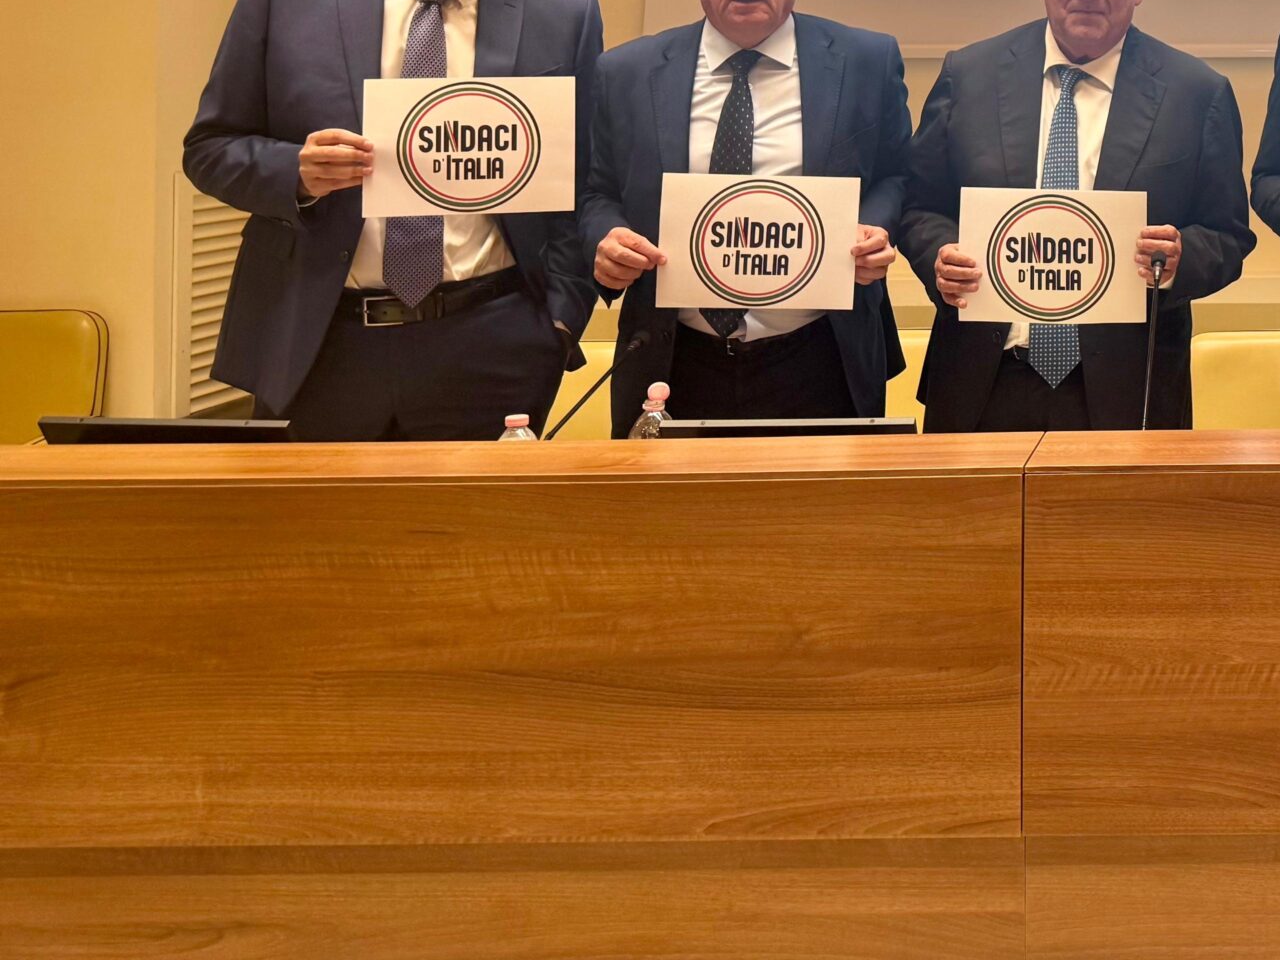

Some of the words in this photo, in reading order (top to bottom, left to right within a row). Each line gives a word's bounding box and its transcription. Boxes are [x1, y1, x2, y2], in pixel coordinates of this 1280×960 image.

[418, 120, 518, 153] SINDACI
[710, 216, 804, 249] SINDACI
[1005, 232, 1094, 264] SINDACI
